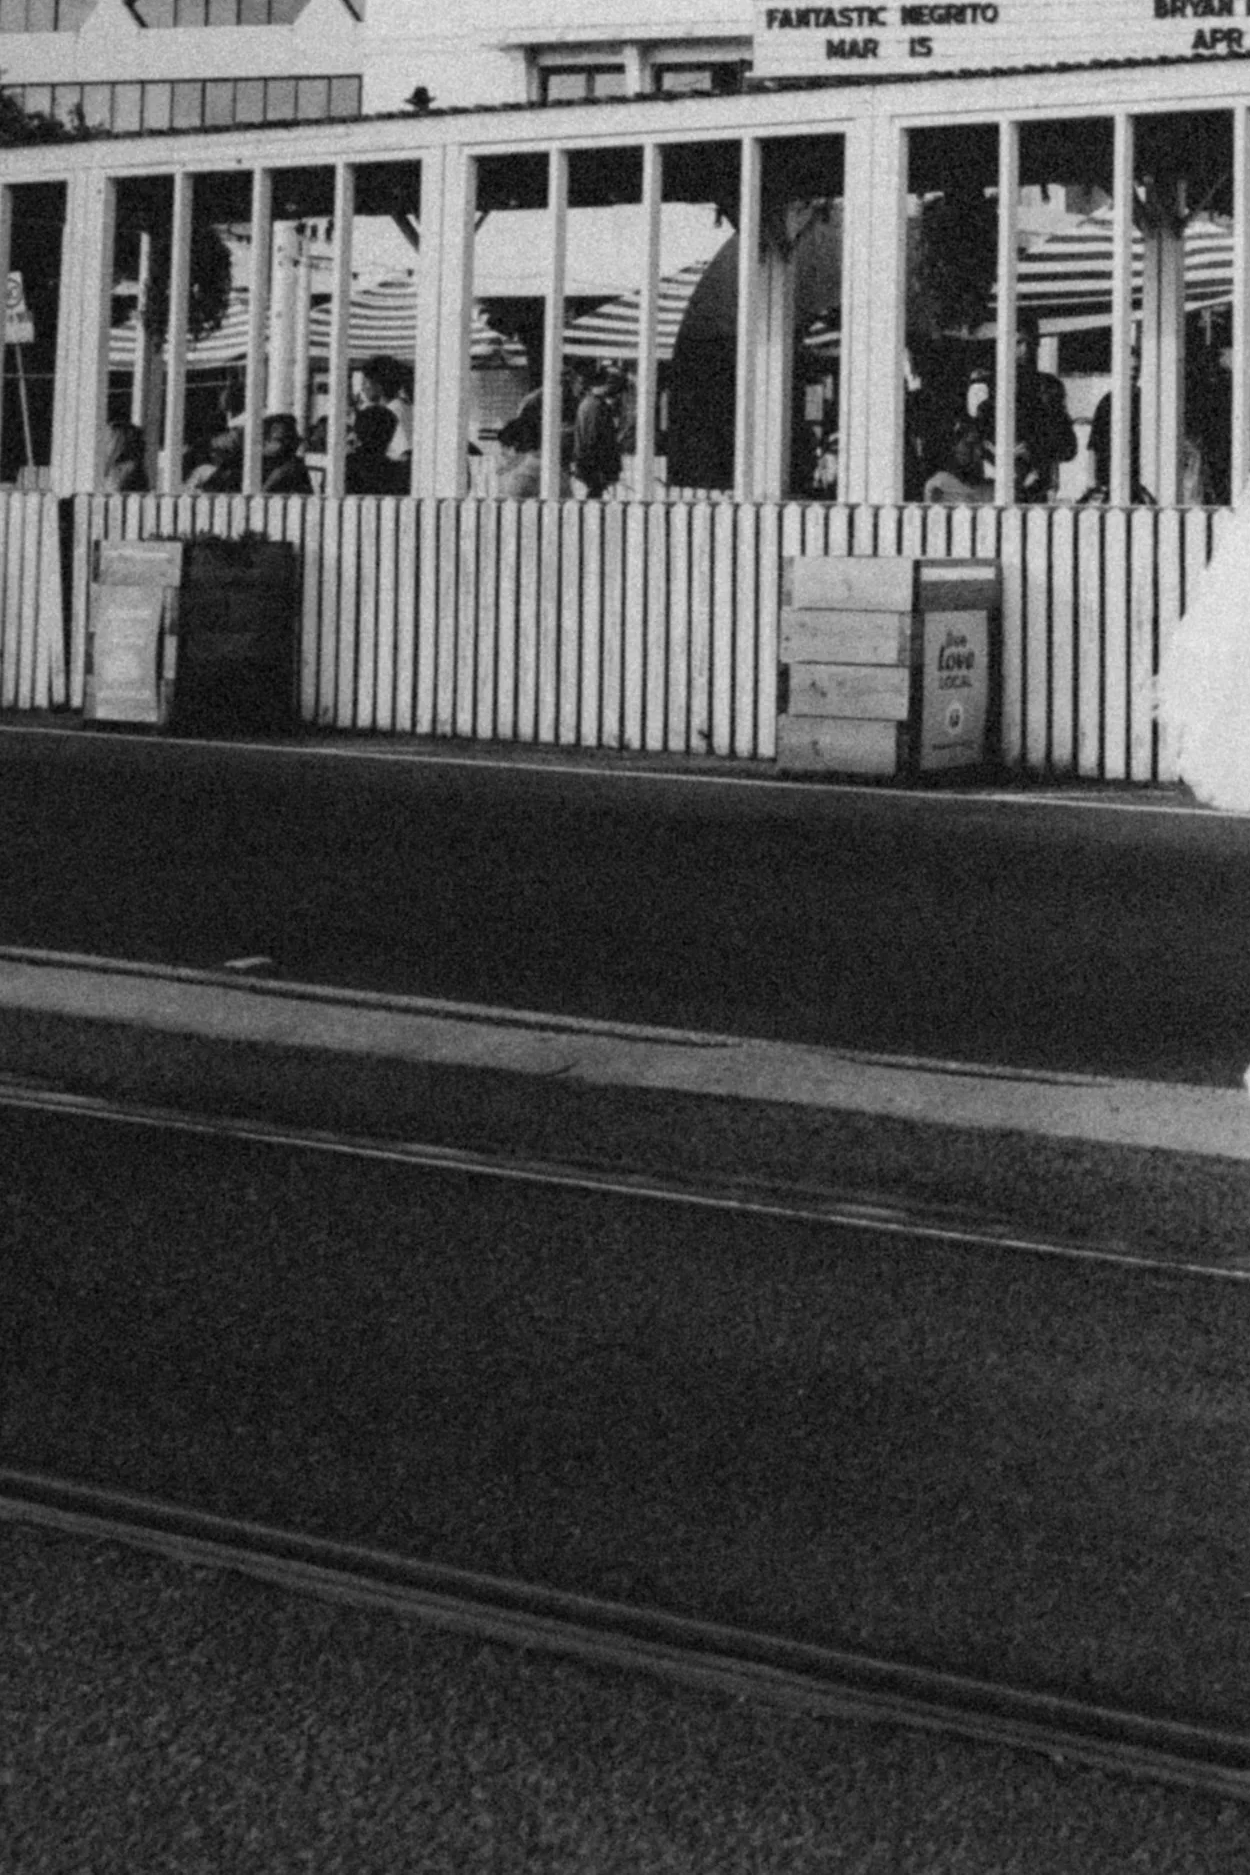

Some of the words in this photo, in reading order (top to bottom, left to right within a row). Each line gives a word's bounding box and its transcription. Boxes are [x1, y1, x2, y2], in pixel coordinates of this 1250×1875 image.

[765, 4, 888, 30] FANTASTIC
[899, 2, 1000, 27] NEGRITO
[825, 37, 880, 60] MAR
[1191, 27, 1244, 50] APR
